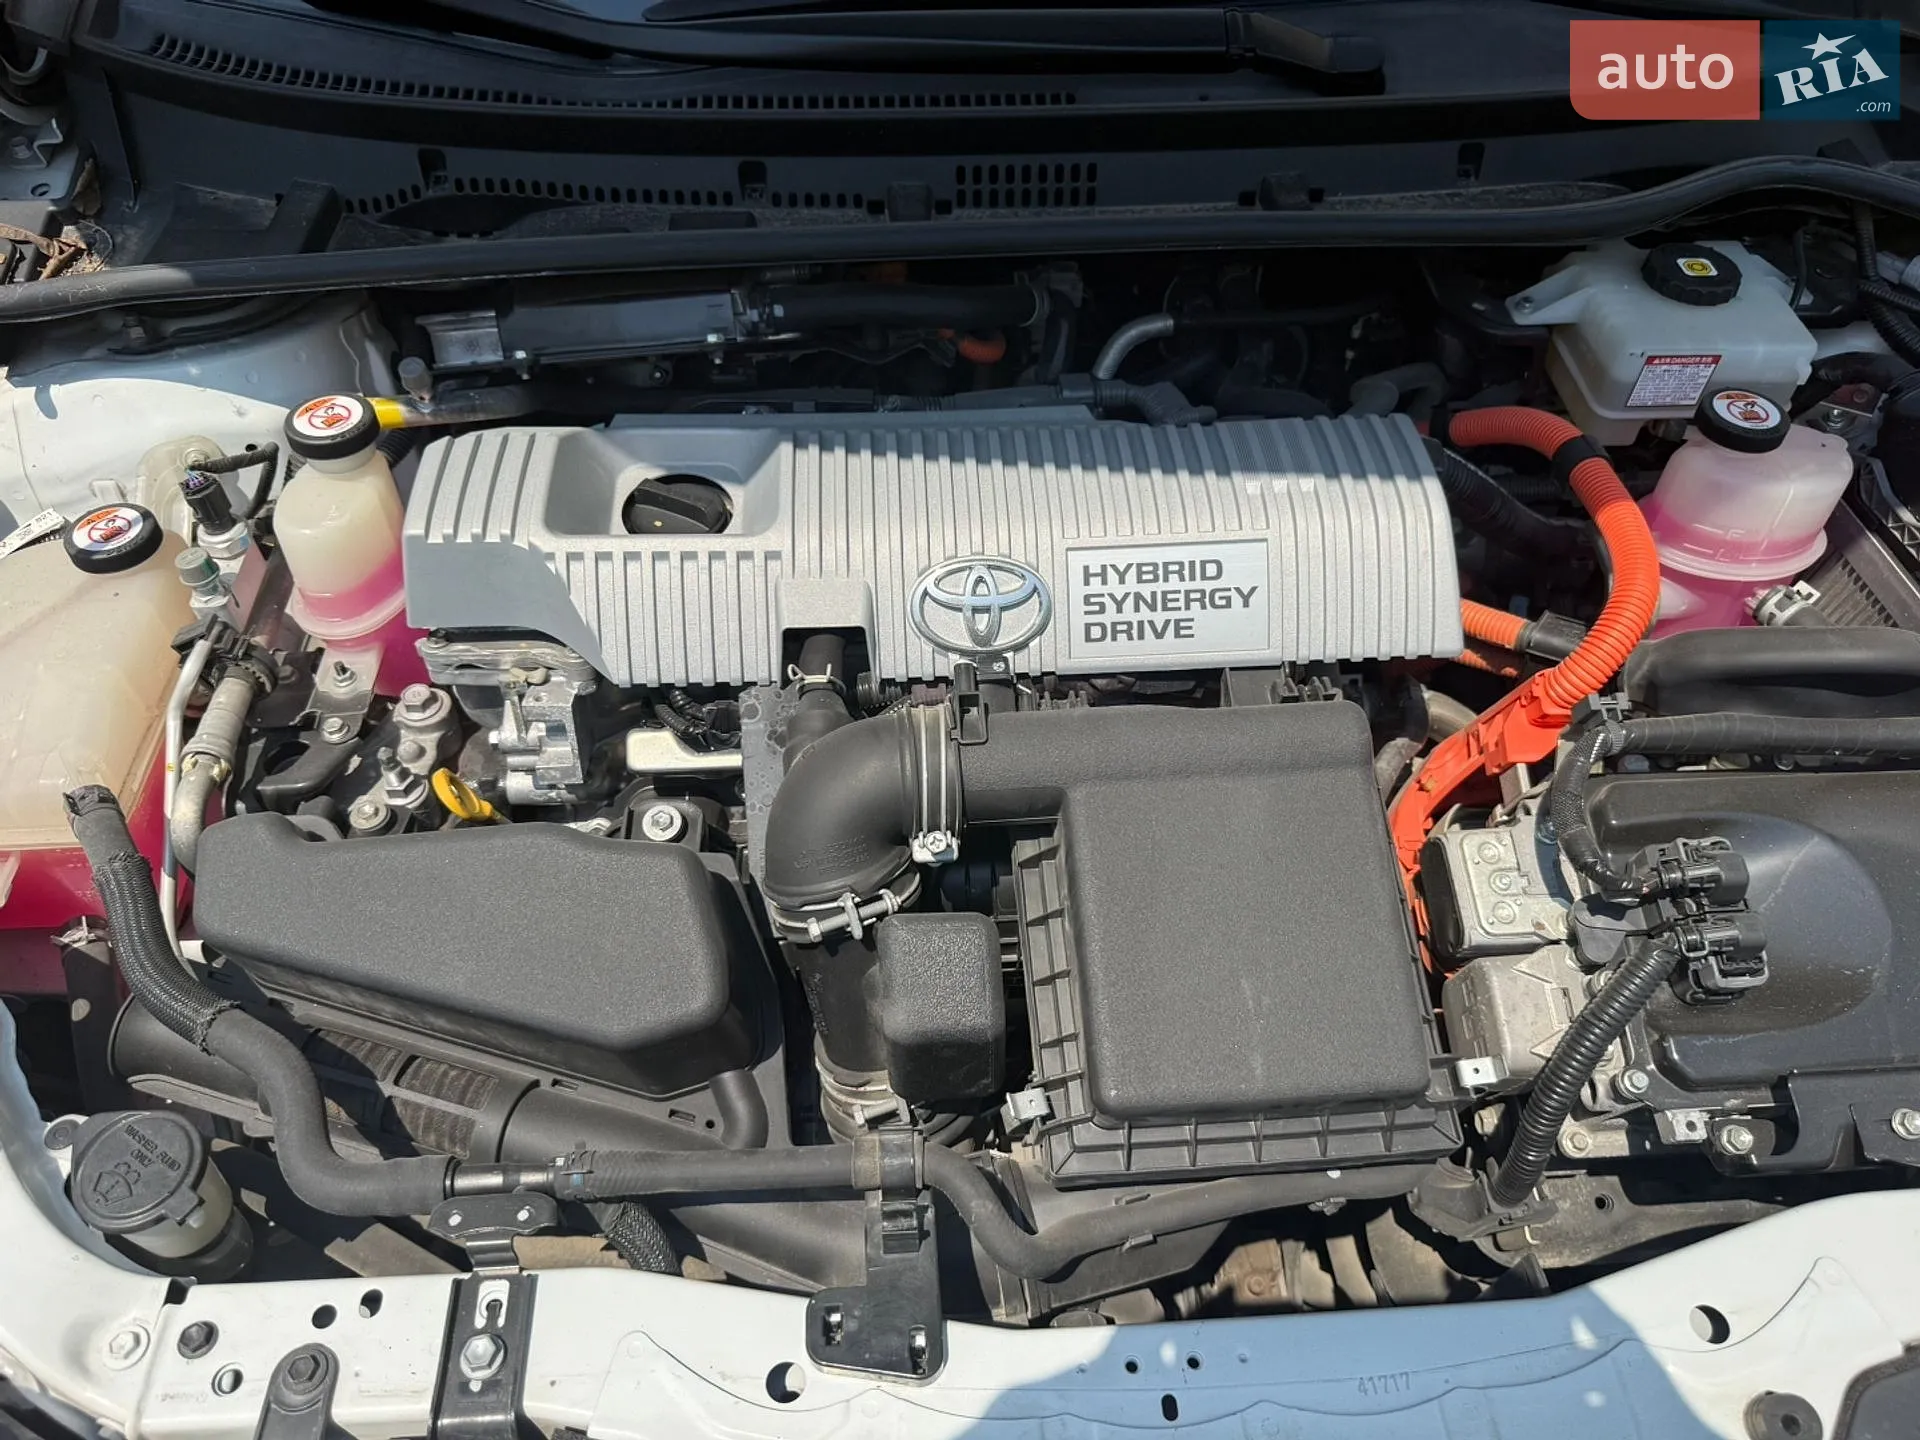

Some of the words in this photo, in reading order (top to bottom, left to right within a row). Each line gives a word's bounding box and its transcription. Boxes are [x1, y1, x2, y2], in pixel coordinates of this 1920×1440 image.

[1082, 558, 1223, 587] HYBRID
[1082, 586, 1259, 616] SYNERGY
[1083, 617, 1195, 643] DRIVE
